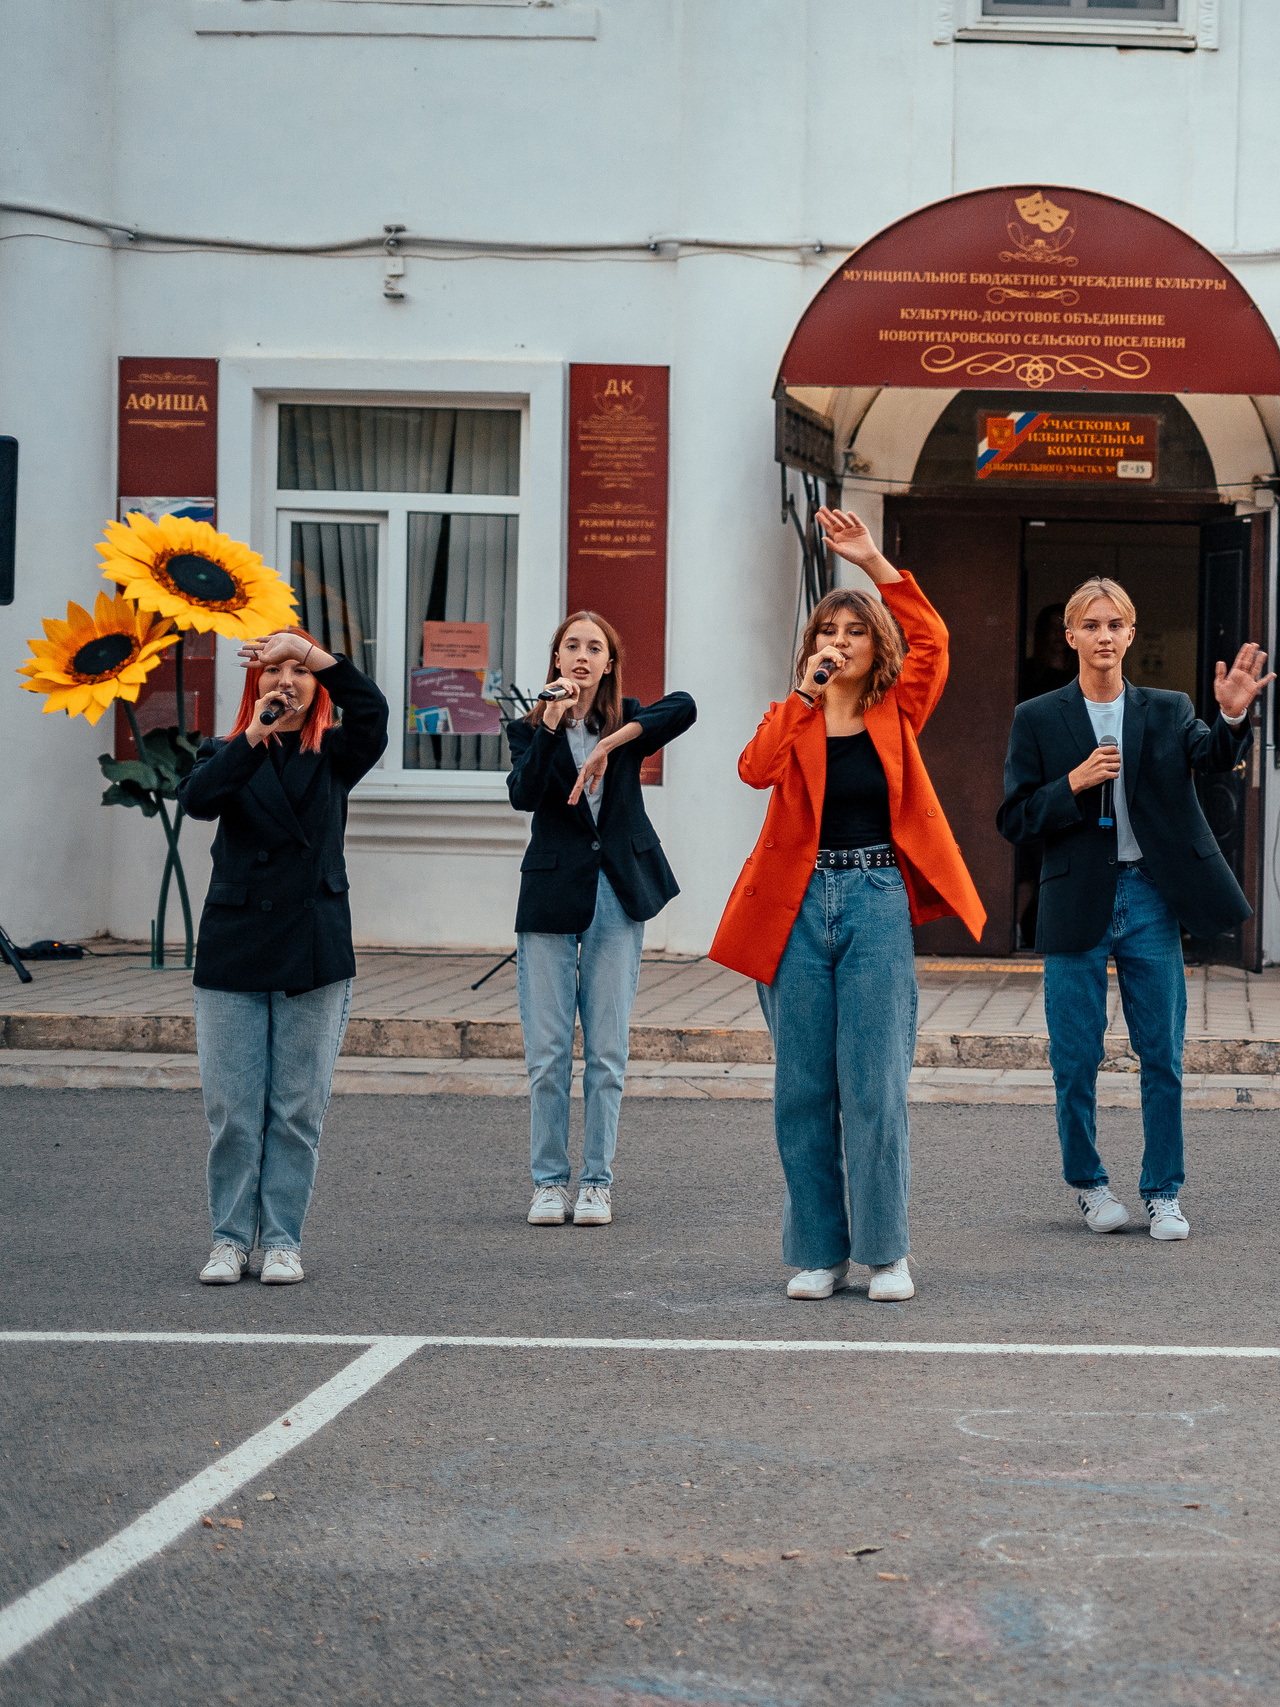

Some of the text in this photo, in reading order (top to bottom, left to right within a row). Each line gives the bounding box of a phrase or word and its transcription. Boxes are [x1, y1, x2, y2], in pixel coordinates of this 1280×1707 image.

[842, 270, 1227, 291] МУНИЦИПАЛЬНОЕ БЮДЖЕТНОЕ УЧРЕЖДЕНИЕ КУЛЬТУРЫ
[900, 308, 1166, 326] КУЛЬТУРНО-ДОСУГОВОЕ ОБЪЕДИНЕНИЕ
[879, 330, 1186, 349] НОВОТИТАРОВСКОГО СЕЛЬСКОГО ПОСЕЛЕНИЯ
[604, 379, 634, 396] ДК
[124, 393, 209, 412] АФИША
[1042, 419, 1131, 432] УЧАСТКОВАЯ
[1028, 432, 1145, 445] ИЗБИРАТЕЛЬНАЯ
[1047, 446, 1124, 458] КОМИССИЯ
